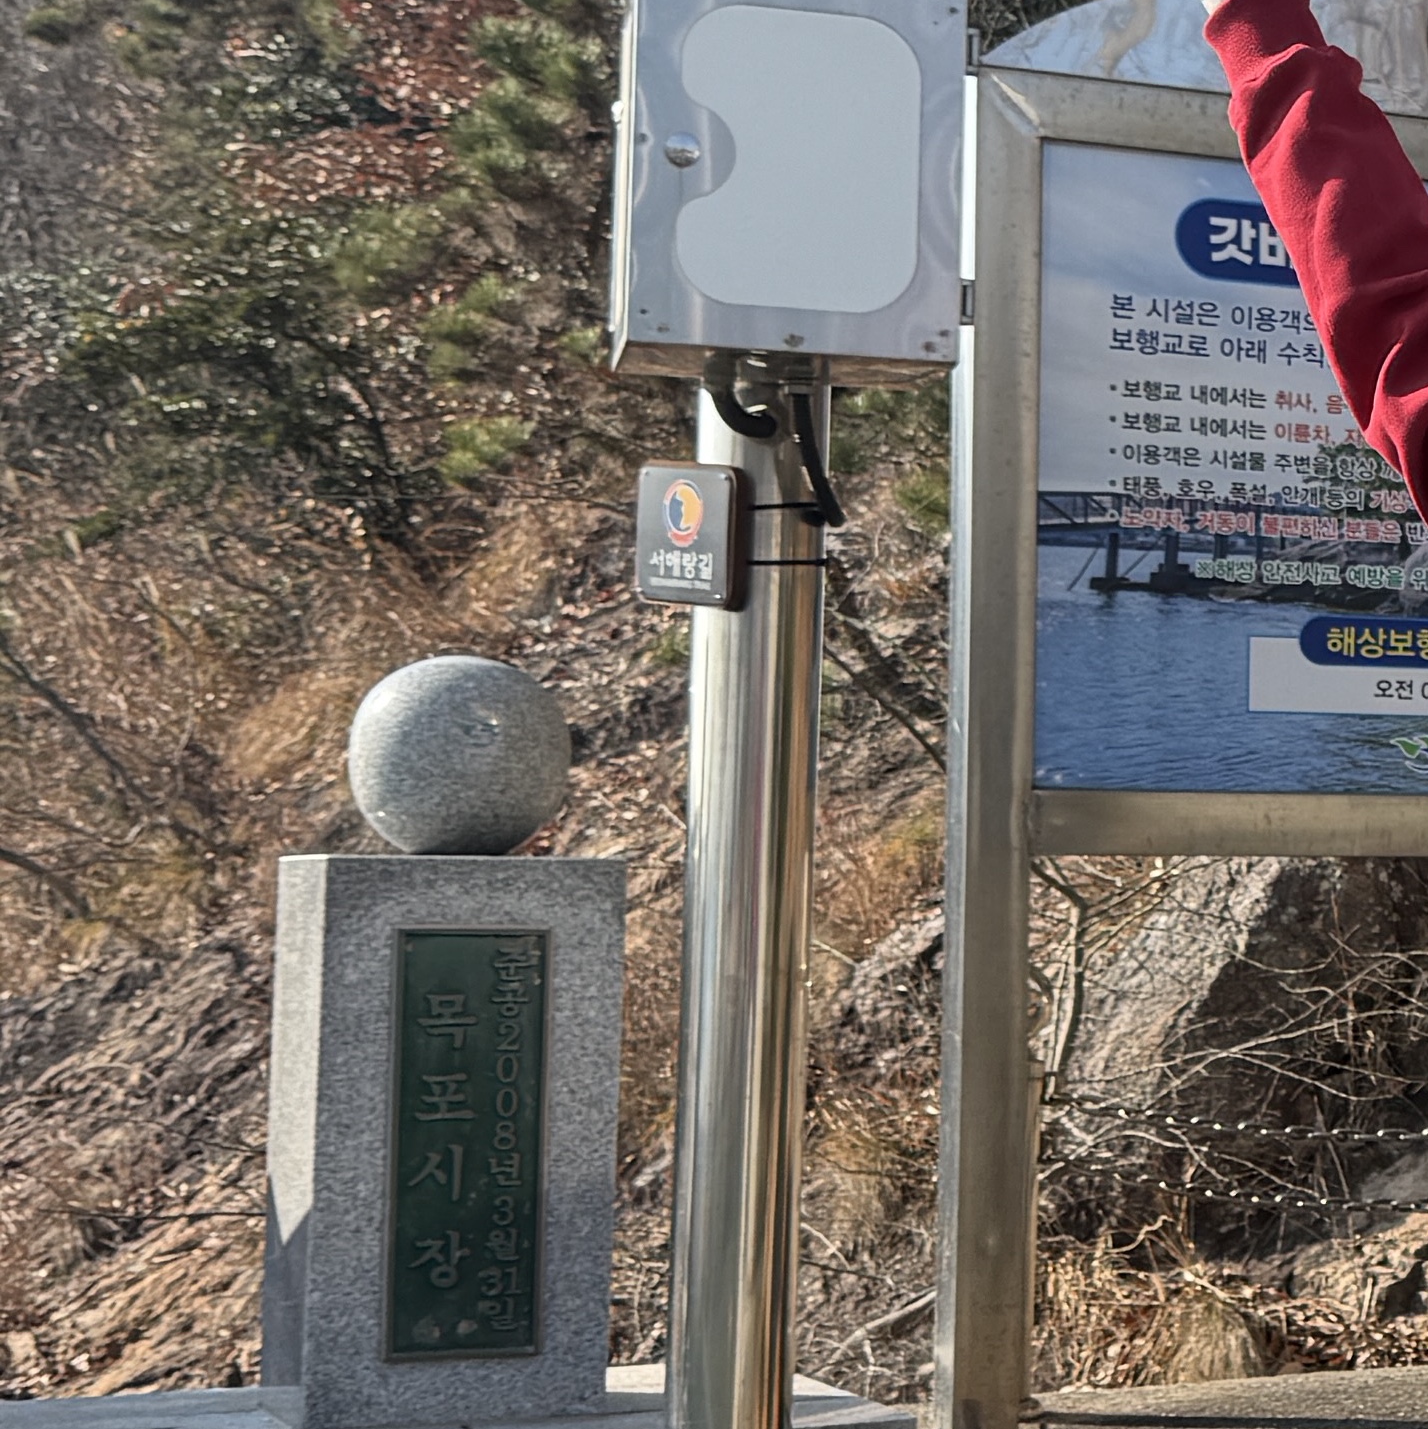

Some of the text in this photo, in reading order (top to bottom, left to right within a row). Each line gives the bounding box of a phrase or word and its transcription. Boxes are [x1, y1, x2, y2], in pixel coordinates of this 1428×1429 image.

[1110, 293, 1136, 320] 본
[1146, 297, 1221, 327] 시설은
[1109, 327, 1210, 358] 보행교로
[1220, 337, 1267, 364] 아래
[1277, 341, 1330, 369] 수칙
[1121, 380, 1182, 402] 보행교
[1190, 385, 1267, 409] 내에서는
[1274, 390, 1317, 413] 취사,
[1326, 394, 1348, 415] 음
[1121, 412, 1182, 434] 보행교
[1190, 416, 1267, 440] 내에서는
[1122, 444, 1202, 468] 이용객은
[1209, 448, 1267, 472] 시설물
[1274, 453, 1332, 478] 주변을
[1336, 456, 1378, 480] 항상
[1122, 476, 1170, 499] 태풍,
[1280, 485, 1321, 507] 안개
[1325, 486, 1365, 511] 등의
[1369, 489, 1414, 514] 기상
[1119, 506, 1190, 533] 노약자,
[1196, 509, 1256, 536] 거동이
[1262, 514, 1340, 540] 불편하신
[1344, 519, 1403, 544] 분들은
[649, 549, 713, 581] 서해랑길
[1262, 559, 1341, 586] 안전사고
[1346, 564, 1405, 590] 예방을
[1374, 680, 1413, 701] 오전
